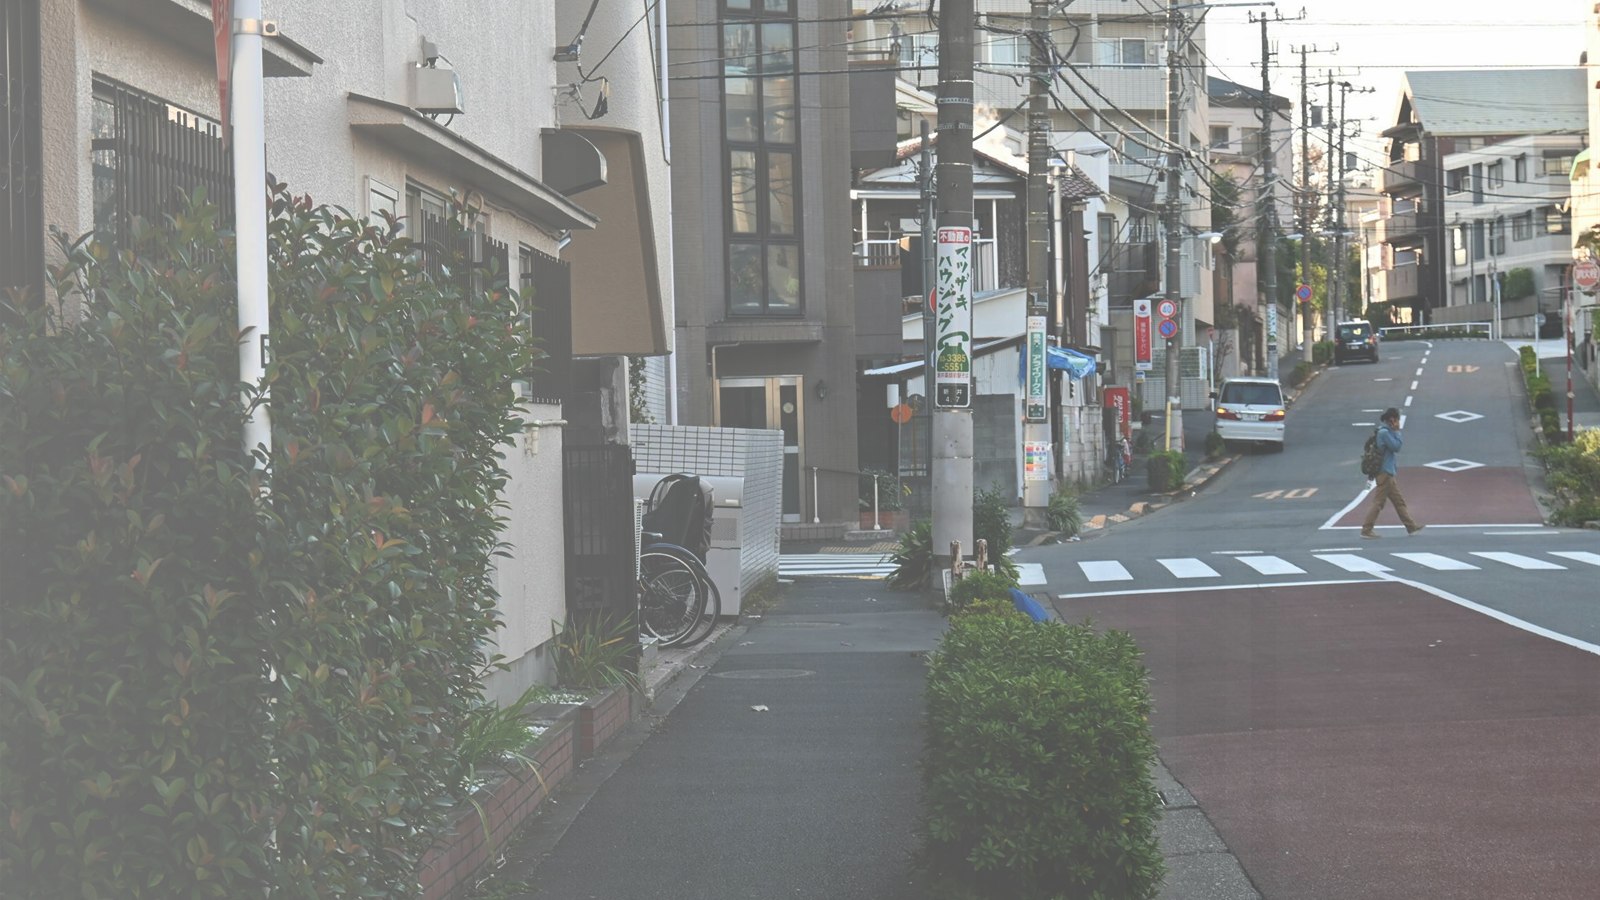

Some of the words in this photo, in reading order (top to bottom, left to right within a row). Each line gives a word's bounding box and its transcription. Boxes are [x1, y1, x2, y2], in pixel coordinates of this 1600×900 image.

[940, 231, 969, 242] 不動産の
[955, 246, 969, 311] マツザキ
[938, 256, 954, 332] ハウジング
[1162, 304, 1173, 314] 40
[1250, 488, 1319, 499] 40
